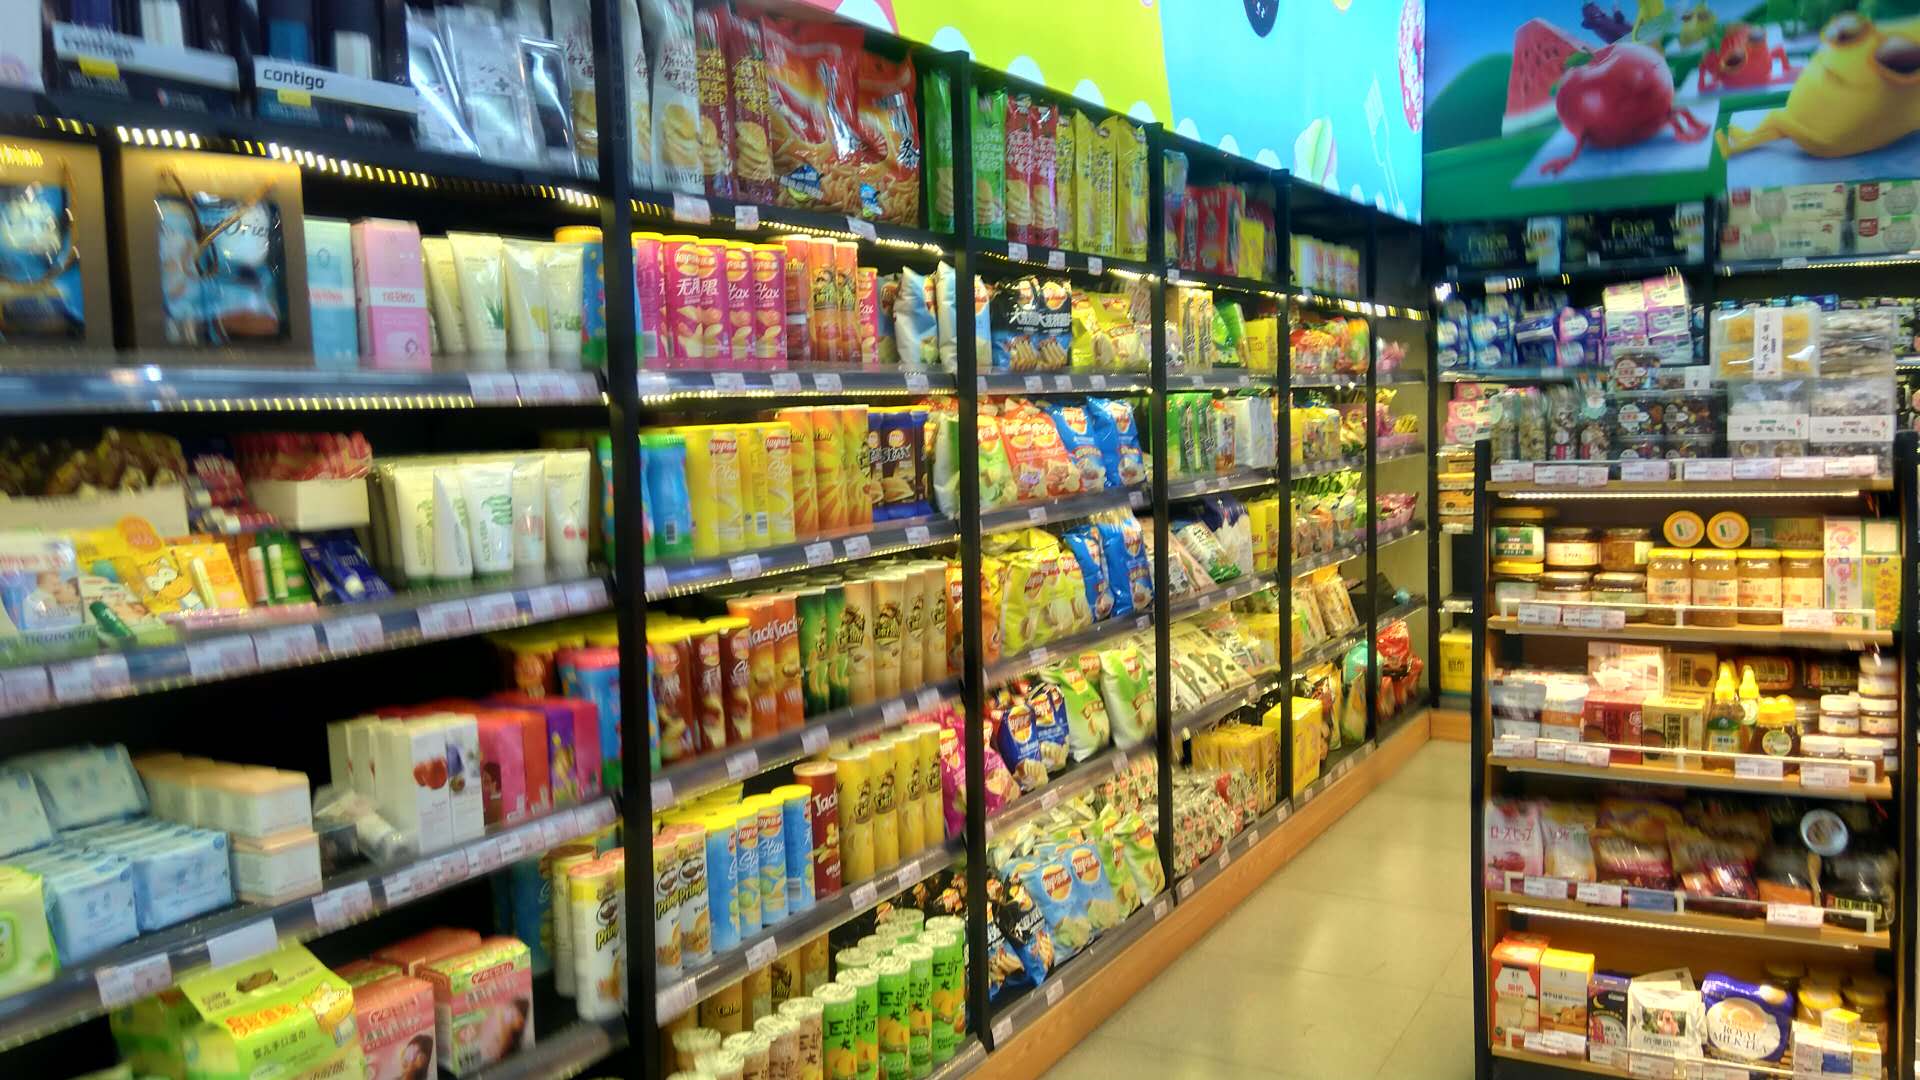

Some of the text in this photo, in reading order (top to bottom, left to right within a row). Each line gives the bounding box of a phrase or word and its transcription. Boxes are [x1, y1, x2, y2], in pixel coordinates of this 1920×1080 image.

[263, 66, 325, 92] contigo
[1712, 1030, 1743, 1047] MILK
[1722, 1024, 1760, 1042] ROYAL
